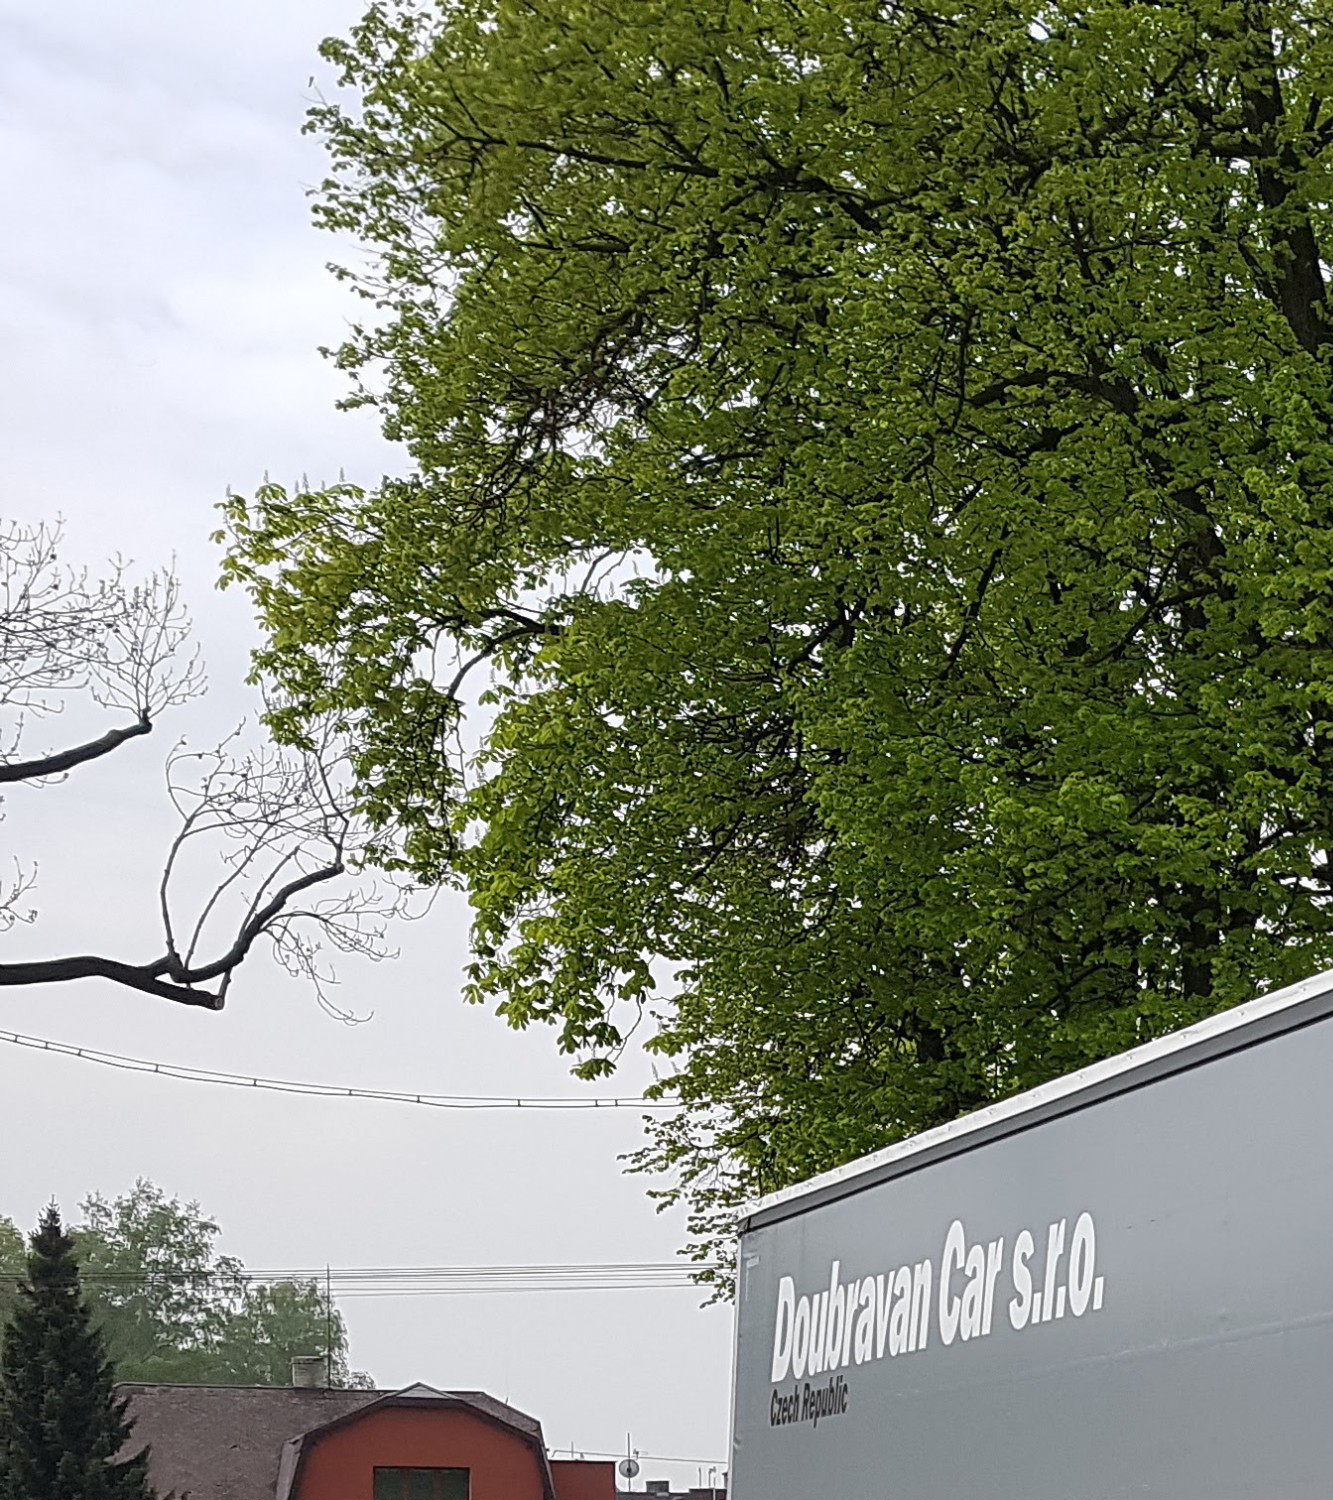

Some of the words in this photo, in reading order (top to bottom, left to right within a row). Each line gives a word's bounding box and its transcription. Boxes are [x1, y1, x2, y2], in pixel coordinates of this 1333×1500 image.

[771, 1259, 933, 1382] Doubravan
[939, 1219, 1004, 1345] Car
[1008, 1211, 1105, 1330] s.r.o.
[770, 1384, 800, 1427] Czech
[801, 1374, 849, 1428] Republic
